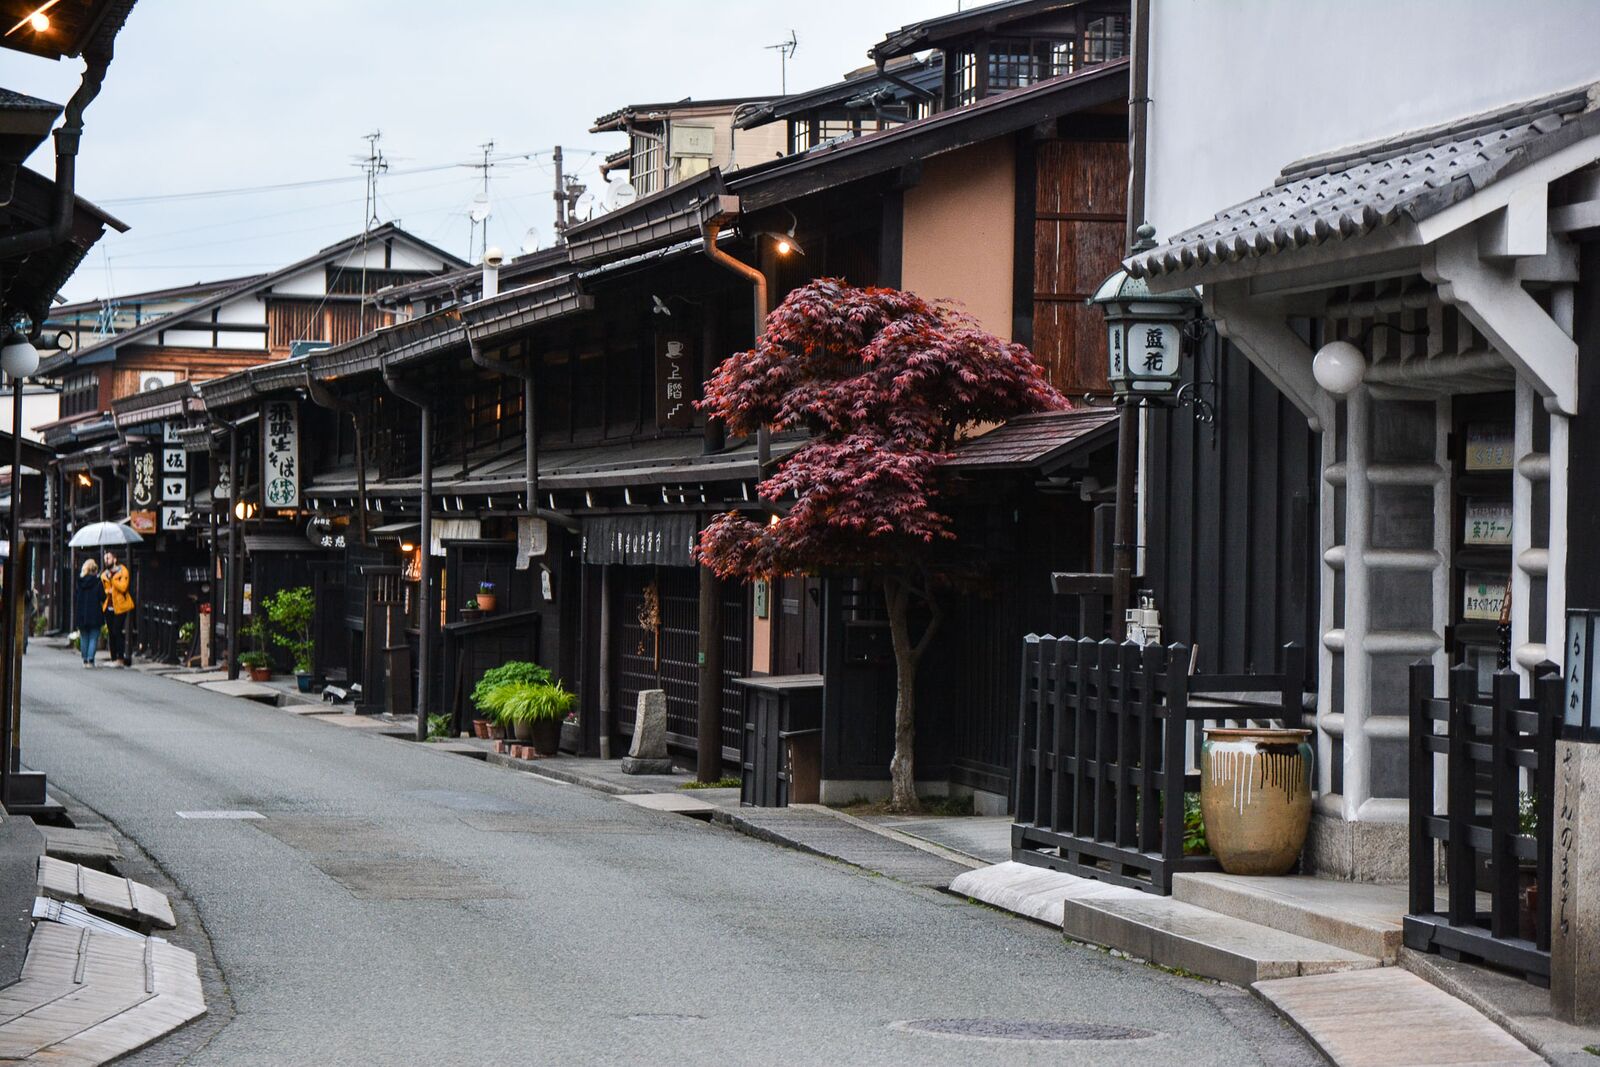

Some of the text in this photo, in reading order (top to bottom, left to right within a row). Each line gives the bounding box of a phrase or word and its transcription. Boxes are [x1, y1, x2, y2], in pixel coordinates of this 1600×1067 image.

[1143, 328, 1164, 371] 藍花
[1570, 632, 1581, 710] らんか
